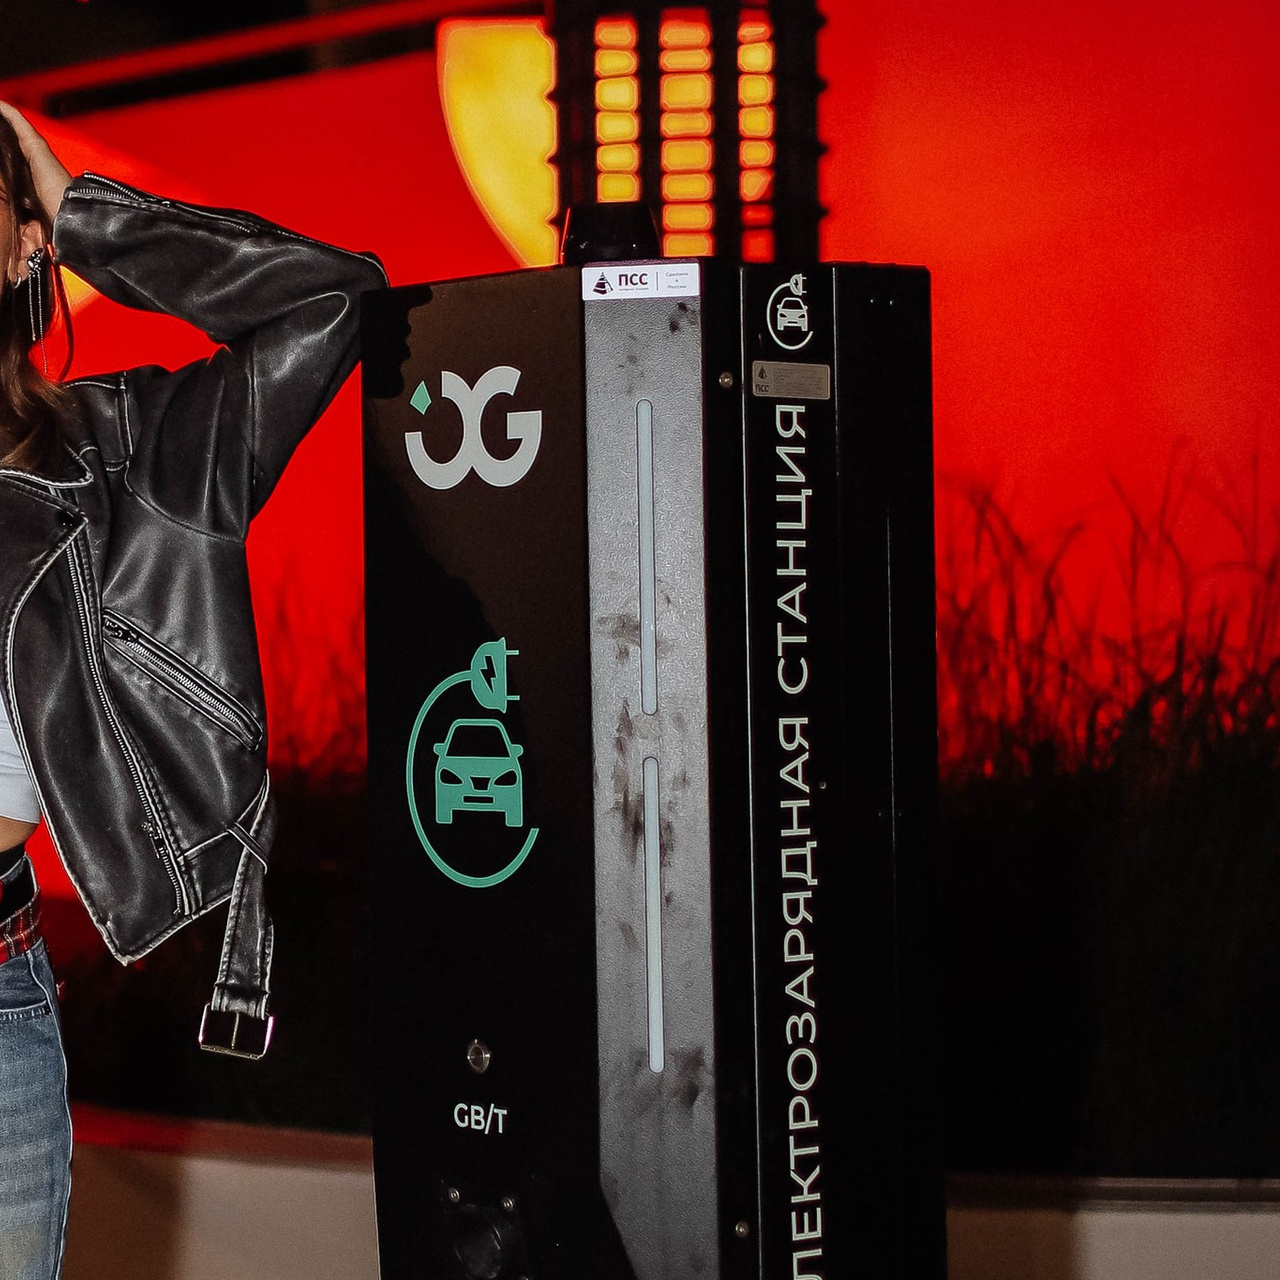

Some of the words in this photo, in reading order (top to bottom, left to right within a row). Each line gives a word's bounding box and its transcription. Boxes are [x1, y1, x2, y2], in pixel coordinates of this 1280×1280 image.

[618, 272, 648, 287] ПСС
[755, 384, 770, 393] ПСС
[775, 404, 813, 695] СТАНЦИЯ
[453, 1102, 508, 1135] GB/T
